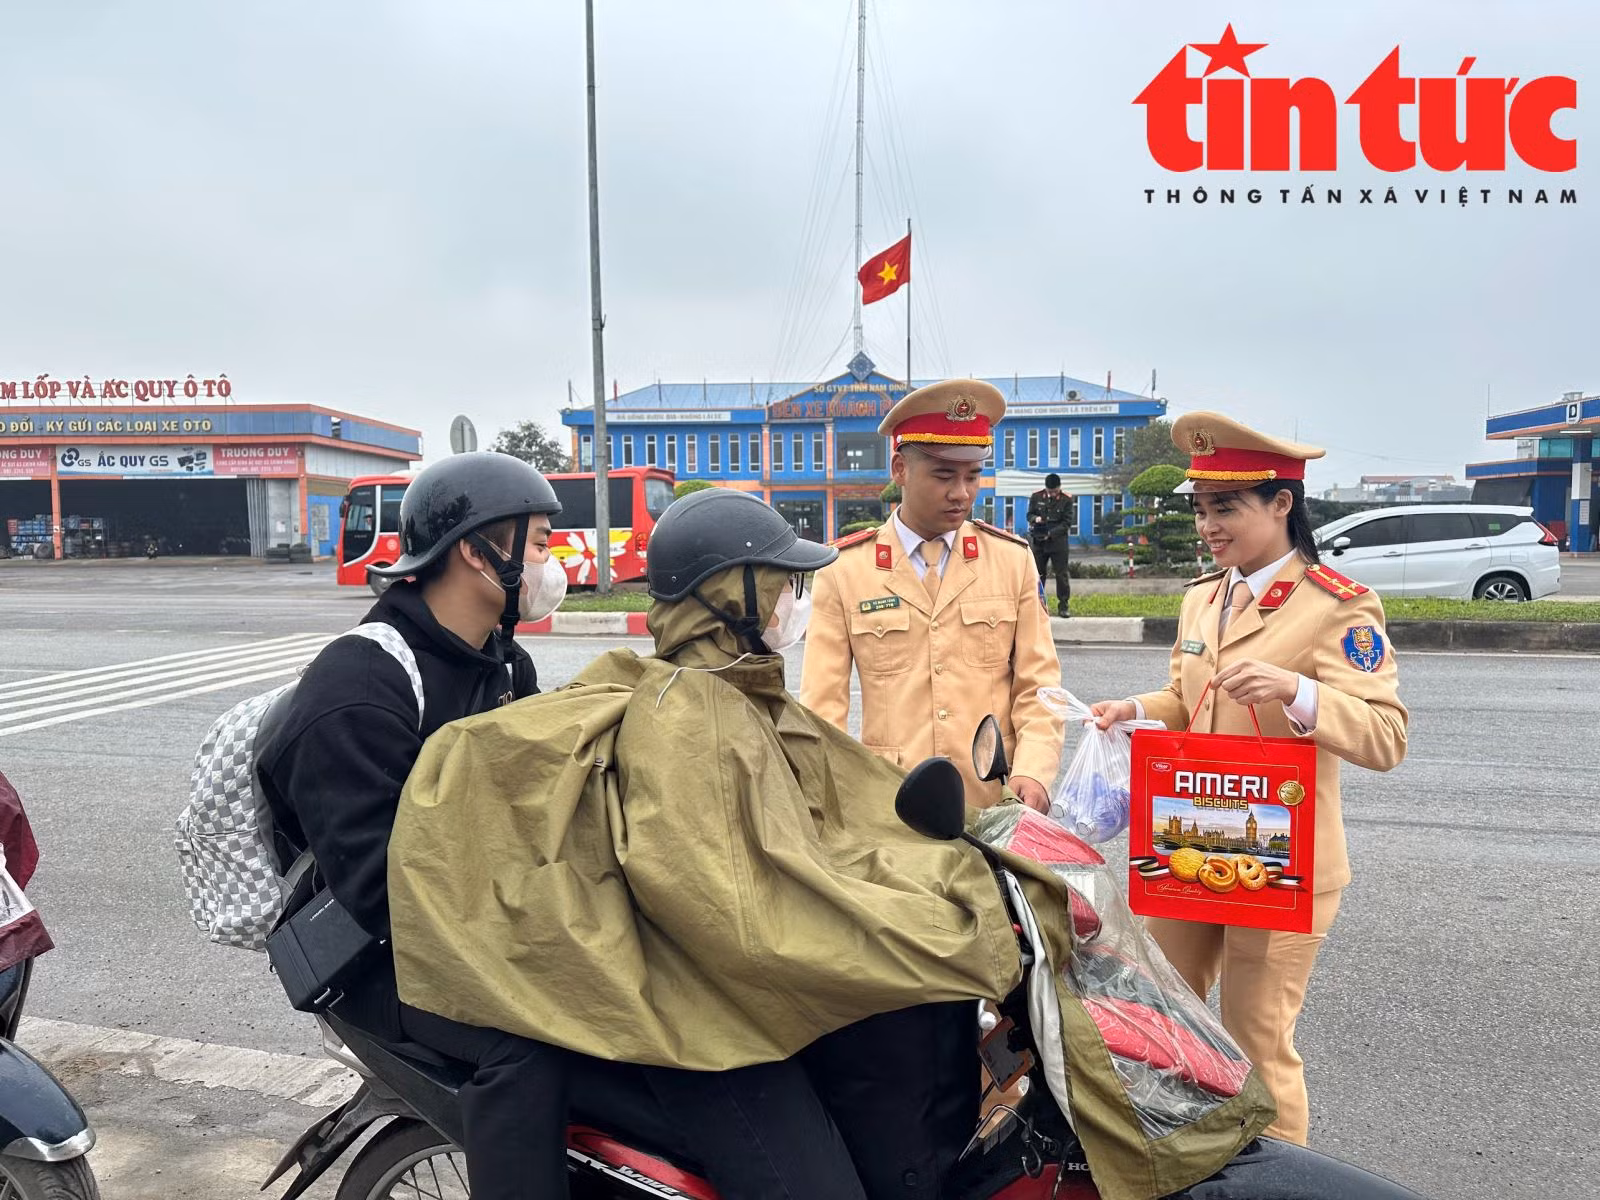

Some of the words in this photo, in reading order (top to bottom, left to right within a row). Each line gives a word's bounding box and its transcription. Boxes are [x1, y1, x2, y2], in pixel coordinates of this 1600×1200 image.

[21, 373, 61, 399] LỐP
[66, 375, 96, 399] VÀ
[134, 379, 178, 402] QUY
[183, 374, 198, 397] Ô
[203, 373, 231, 397] TÔ
[96, 417, 123, 433] CÁC
[161, 420, 179, 432] XE
[20, 449, 42, 459] DUY
[267, 447, 290, 457] DUY
[78, 459, 91, 467] GS
[120, 455, 145, 468] QUY
[149, 455, 169, 467] GS
[1175, 771, 1268, 799] AMERI
[1193, 797, 1249, 810] BISCUITS
